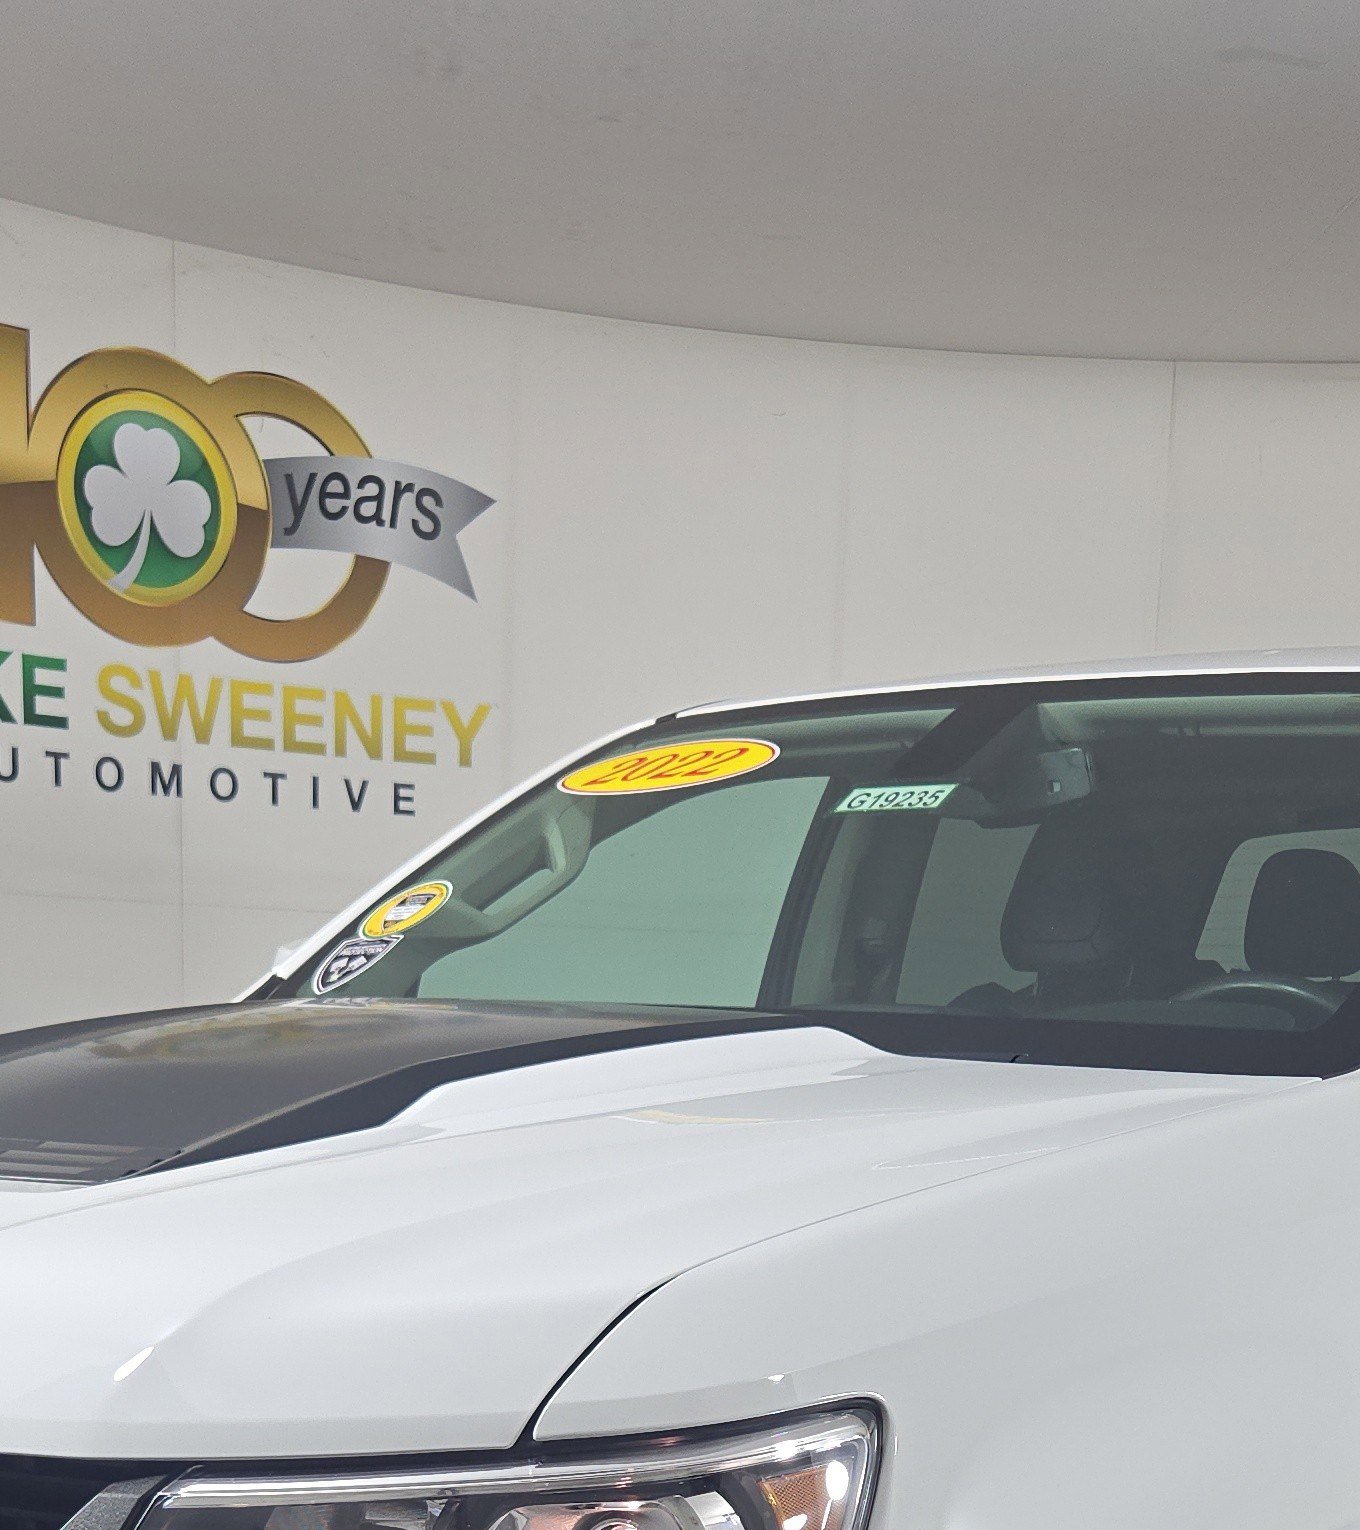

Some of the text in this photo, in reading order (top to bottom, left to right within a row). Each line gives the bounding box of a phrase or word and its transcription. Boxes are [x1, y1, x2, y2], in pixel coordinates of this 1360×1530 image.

[282, 470, 444, 541] years
[95, 663, 491, 768] SWEENEY
[581, 747, 750, 787] 2022
[847, 790, 946, 810] G19235
